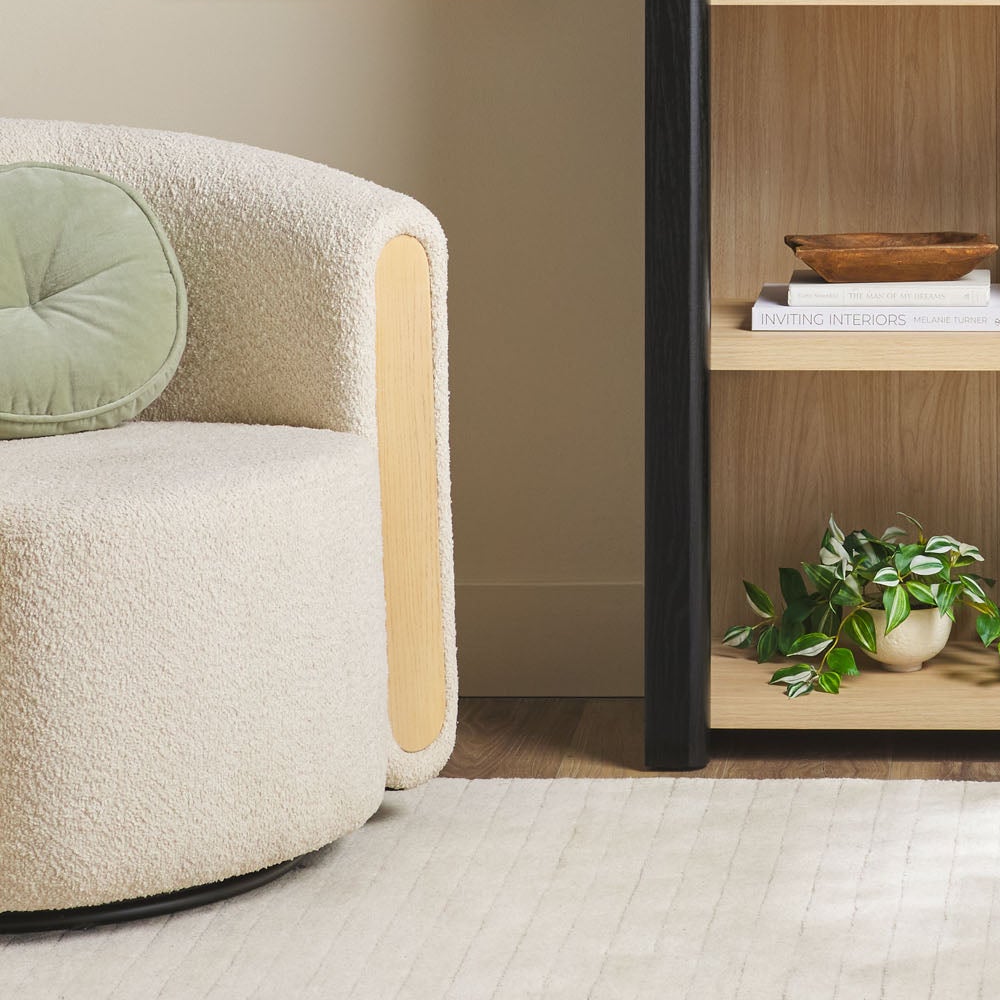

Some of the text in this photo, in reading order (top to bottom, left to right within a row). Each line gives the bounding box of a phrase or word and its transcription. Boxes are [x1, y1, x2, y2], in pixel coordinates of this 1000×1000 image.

[848, 292, 862, 300] THE
[866, 292, 884, 300] MAN
[886, 292, 897, 300] OF
[761, 313, 907, 326] INVITING INTERIORS
[913, 315, 987, 324] MELANIE TURNER
